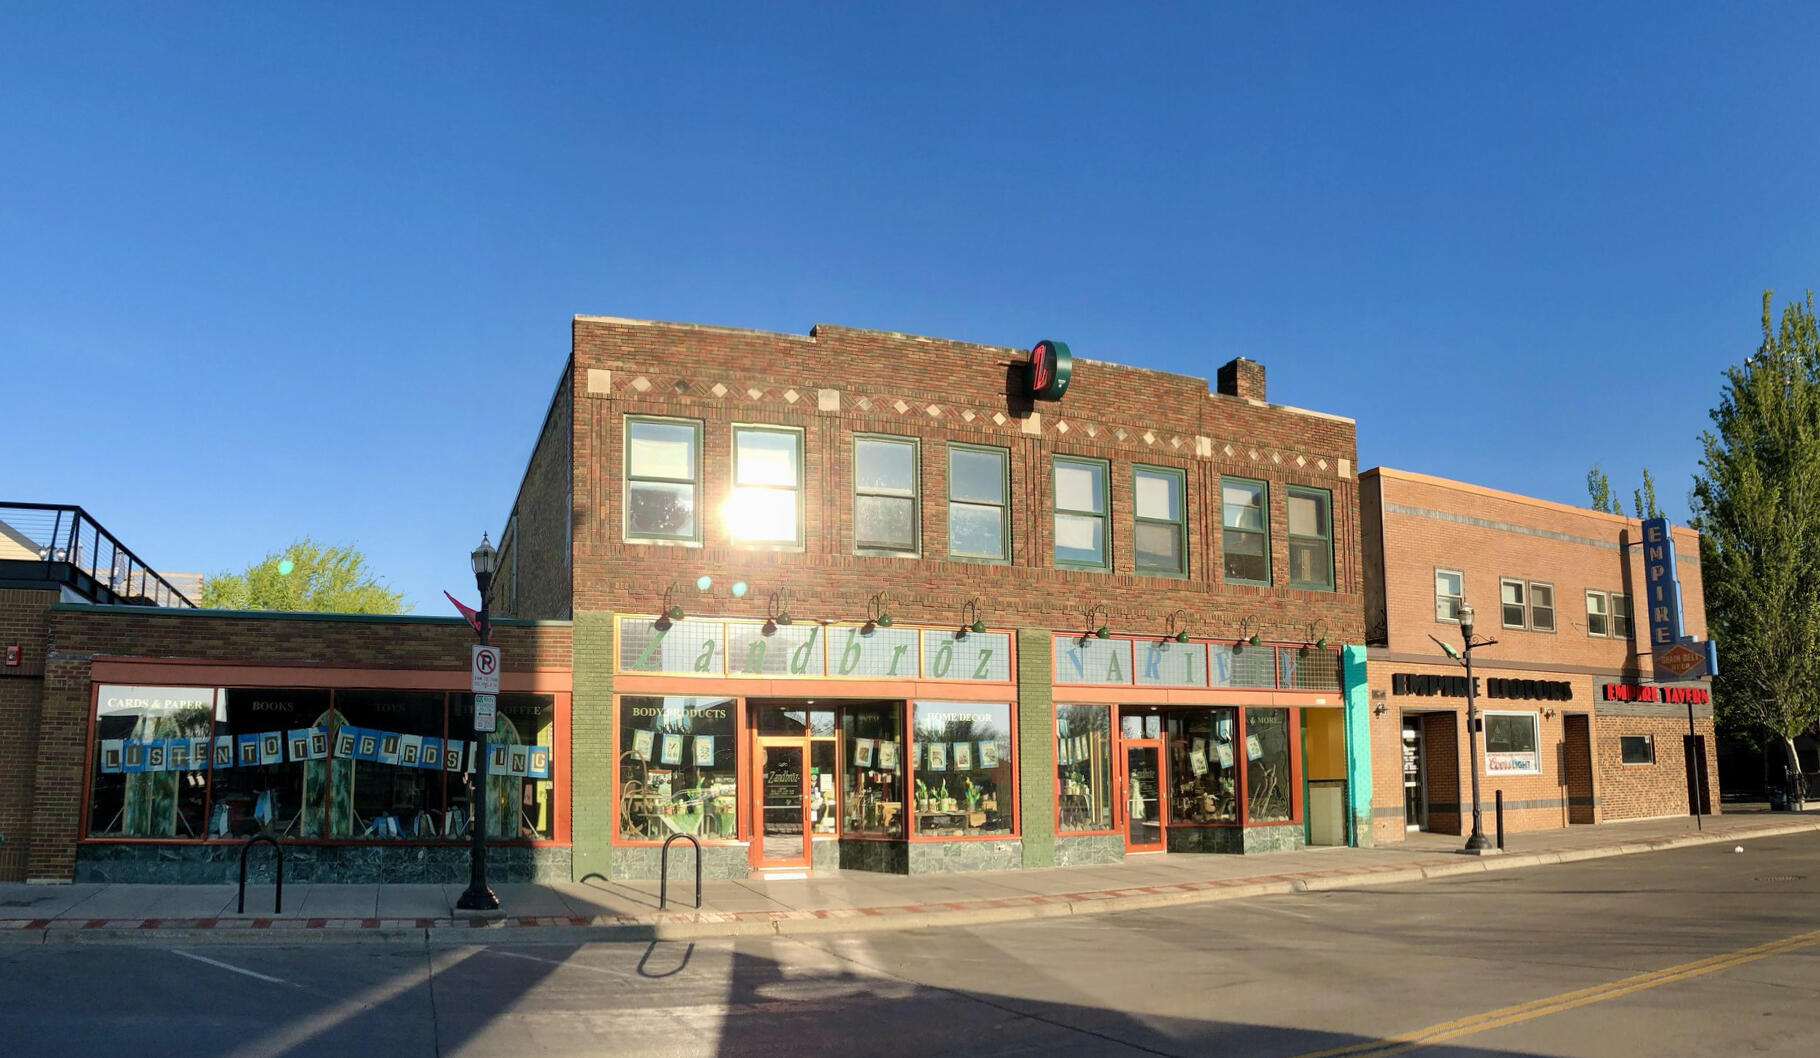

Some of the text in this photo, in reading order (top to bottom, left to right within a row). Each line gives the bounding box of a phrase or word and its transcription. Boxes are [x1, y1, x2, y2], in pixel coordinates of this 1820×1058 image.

[1648, 526, 1671, 643] EMPIRE
[1066, 646, 1297, 685] VARIETY
[1603, 683, 1710, 705] EMPIRE TAVERN
[107, 698, 203, 710] CARDS & PAPER
[252, 700, 294, 712] BOOKS
[376, 703, 406, 713] TOYS
[632, 707, 664, 717] BODY
[927, 712, 993, 722] HOME DECOR
[105, 741, 230, 769] LISTEN
[242, 735, 279, 761] TO
